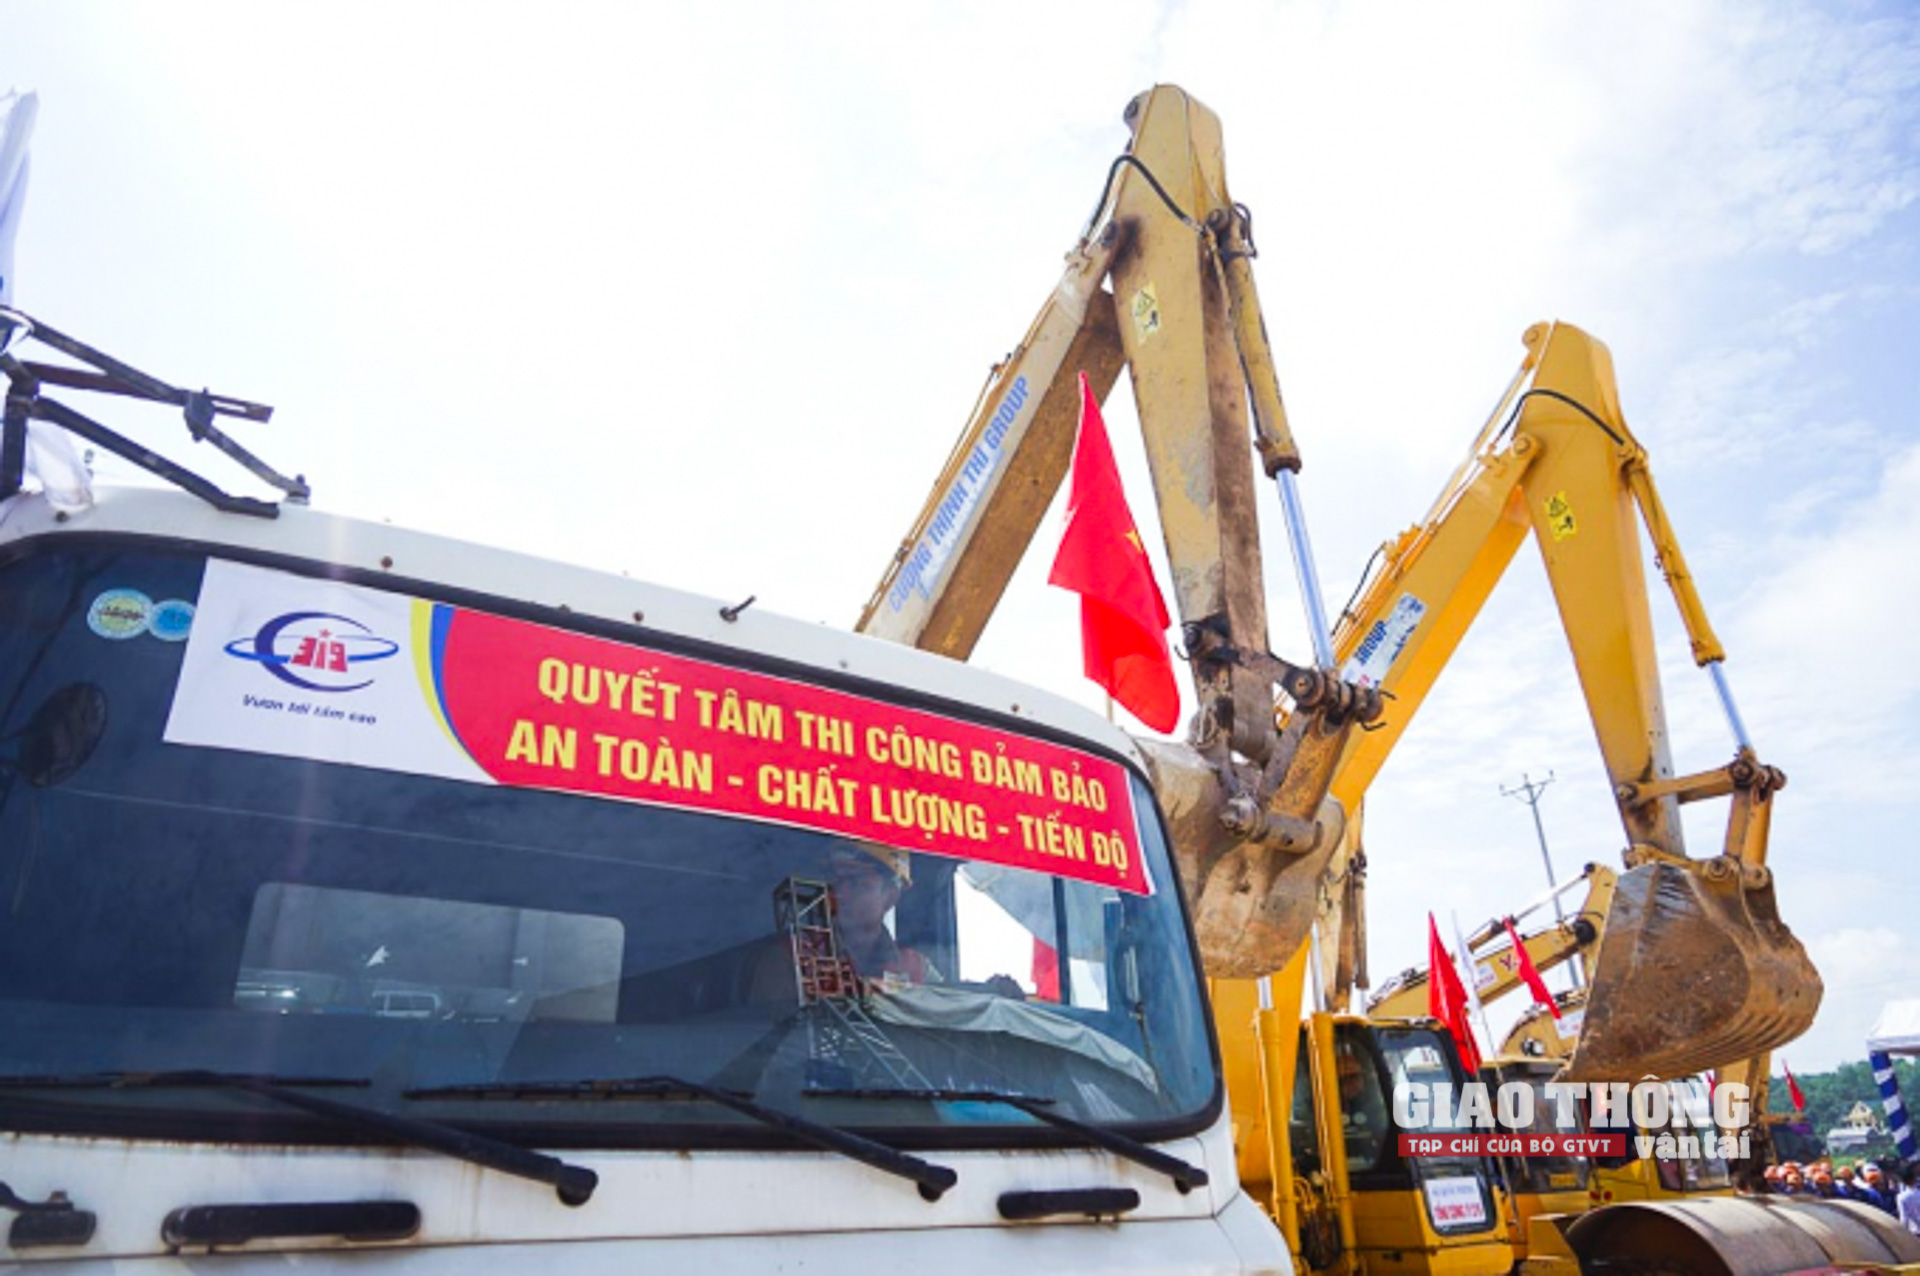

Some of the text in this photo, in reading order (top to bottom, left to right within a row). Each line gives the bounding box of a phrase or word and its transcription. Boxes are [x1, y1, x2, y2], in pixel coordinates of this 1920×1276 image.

[984, 375, 1029, 450] GROUP
[505, 718, 578, 771] AN
[593, 736, 714, 795] TOÀN
[757, 763, 859, 818] CHẤT
[870, 785, 988, 841] LƯỢNG
[1016, 809, 1088, 862] TIẾN
[1091, 829, 1130, 880] ĐỘ
[538, 656, 1108, 812] QUYẾT TÂM THI CÔNG ĐẢM BẢO
